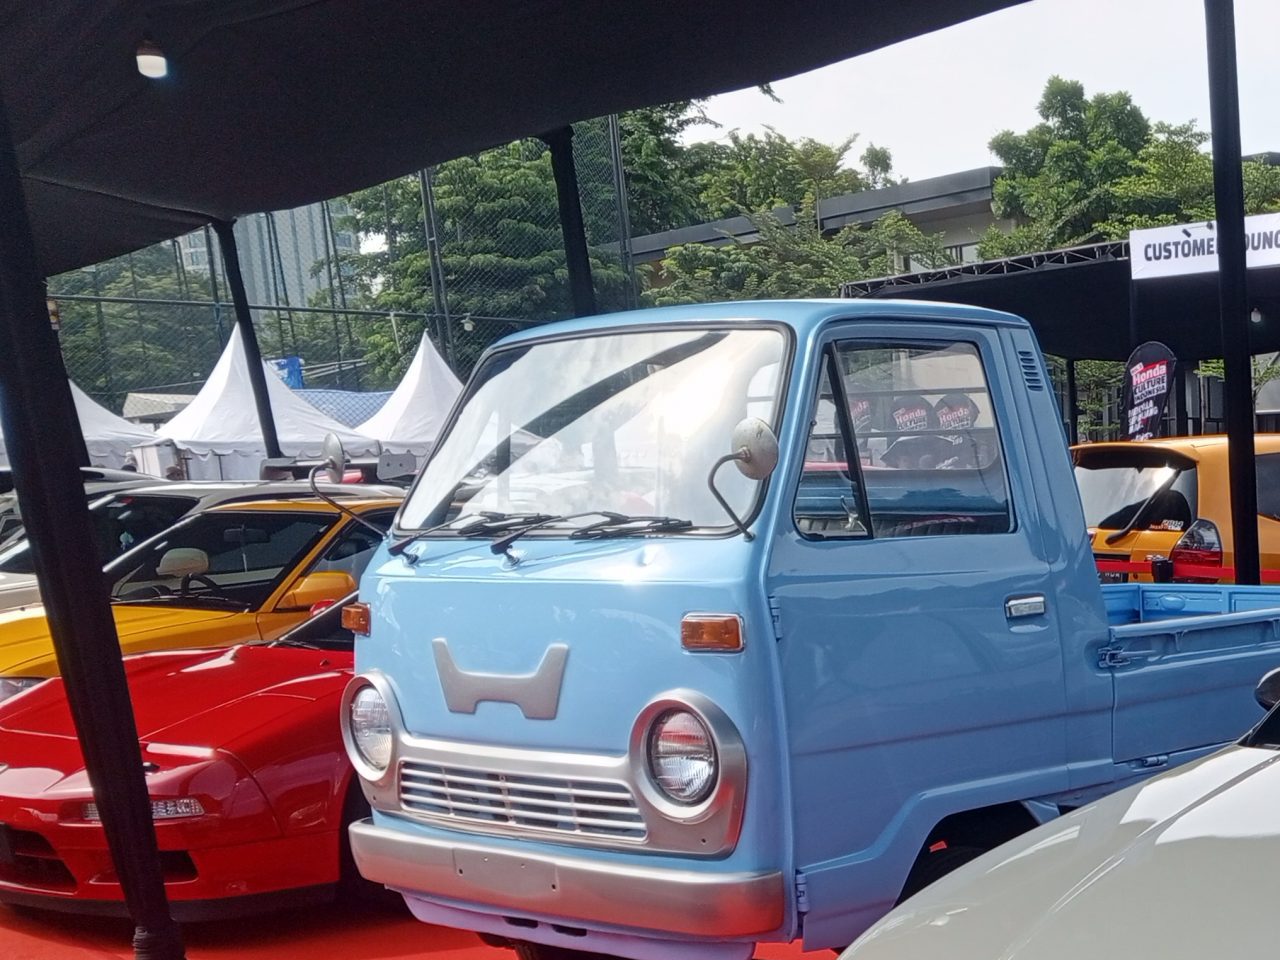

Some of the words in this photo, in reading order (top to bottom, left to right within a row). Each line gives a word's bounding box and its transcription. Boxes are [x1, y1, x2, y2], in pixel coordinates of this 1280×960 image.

[1144, 237, 1218, 262] CUSTOME
[1133, 364, 1167, 386] Honda
[1134, 375, 1166, 395] CULTURE
